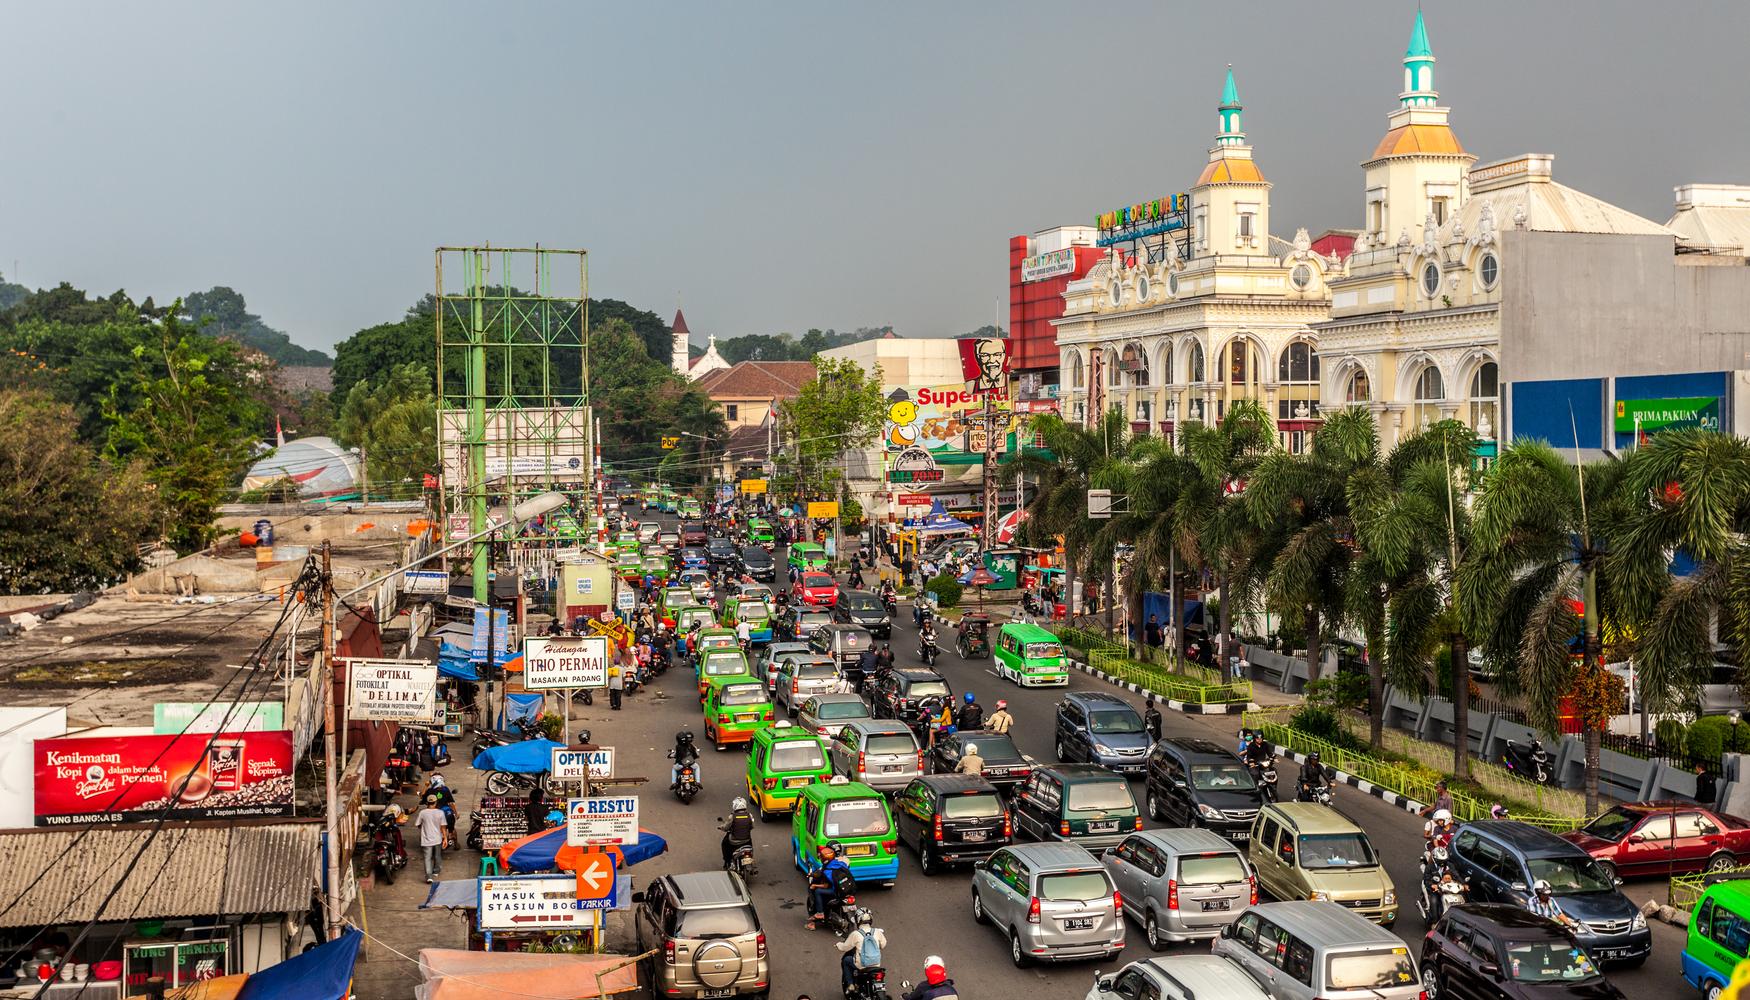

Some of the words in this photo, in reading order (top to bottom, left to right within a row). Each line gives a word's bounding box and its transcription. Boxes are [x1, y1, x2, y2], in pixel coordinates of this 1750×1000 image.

[1096, 208, 1123, 231] TAMAN
[1124, 202, 1146, 224] TOPI
[1147, 192, 1184, 221] SQUARE
[1633, 411, 1660, 422] PRIMA
[1662, 410, 1698, 421] PAKUAN
[544, 644, 588, 656] Hidangan
[529, 658, 555, 672] TRIO
[560, 657, 603, 671] PERMAI
[376, 669, 412, 680] OPTIKAL
[531, 676, 568, 684] MASAKAN
[46, 751, 121, 766] Kenikmatan
[247, 758, 276, 769] Seenak
[559, 752, 608, 765] OPTIKAL
[56, 766, 82, 780] Kopi
[107, 765, 132, 774] dalam
[253, 766, 282, 777] Kopinya
[564, 767, 602, 776] DELMA
[214, 808, 236, 817] Kapten
[264, 806, 283, 815] Bogor
[587, 799, 634, 813] RESTU
[46, 816, 71, 824] YUNG
[111, 813, 123, 821] ES
[581, 899, 612, 909] PARKIR
[132, 948, 166, 958] YUNG
